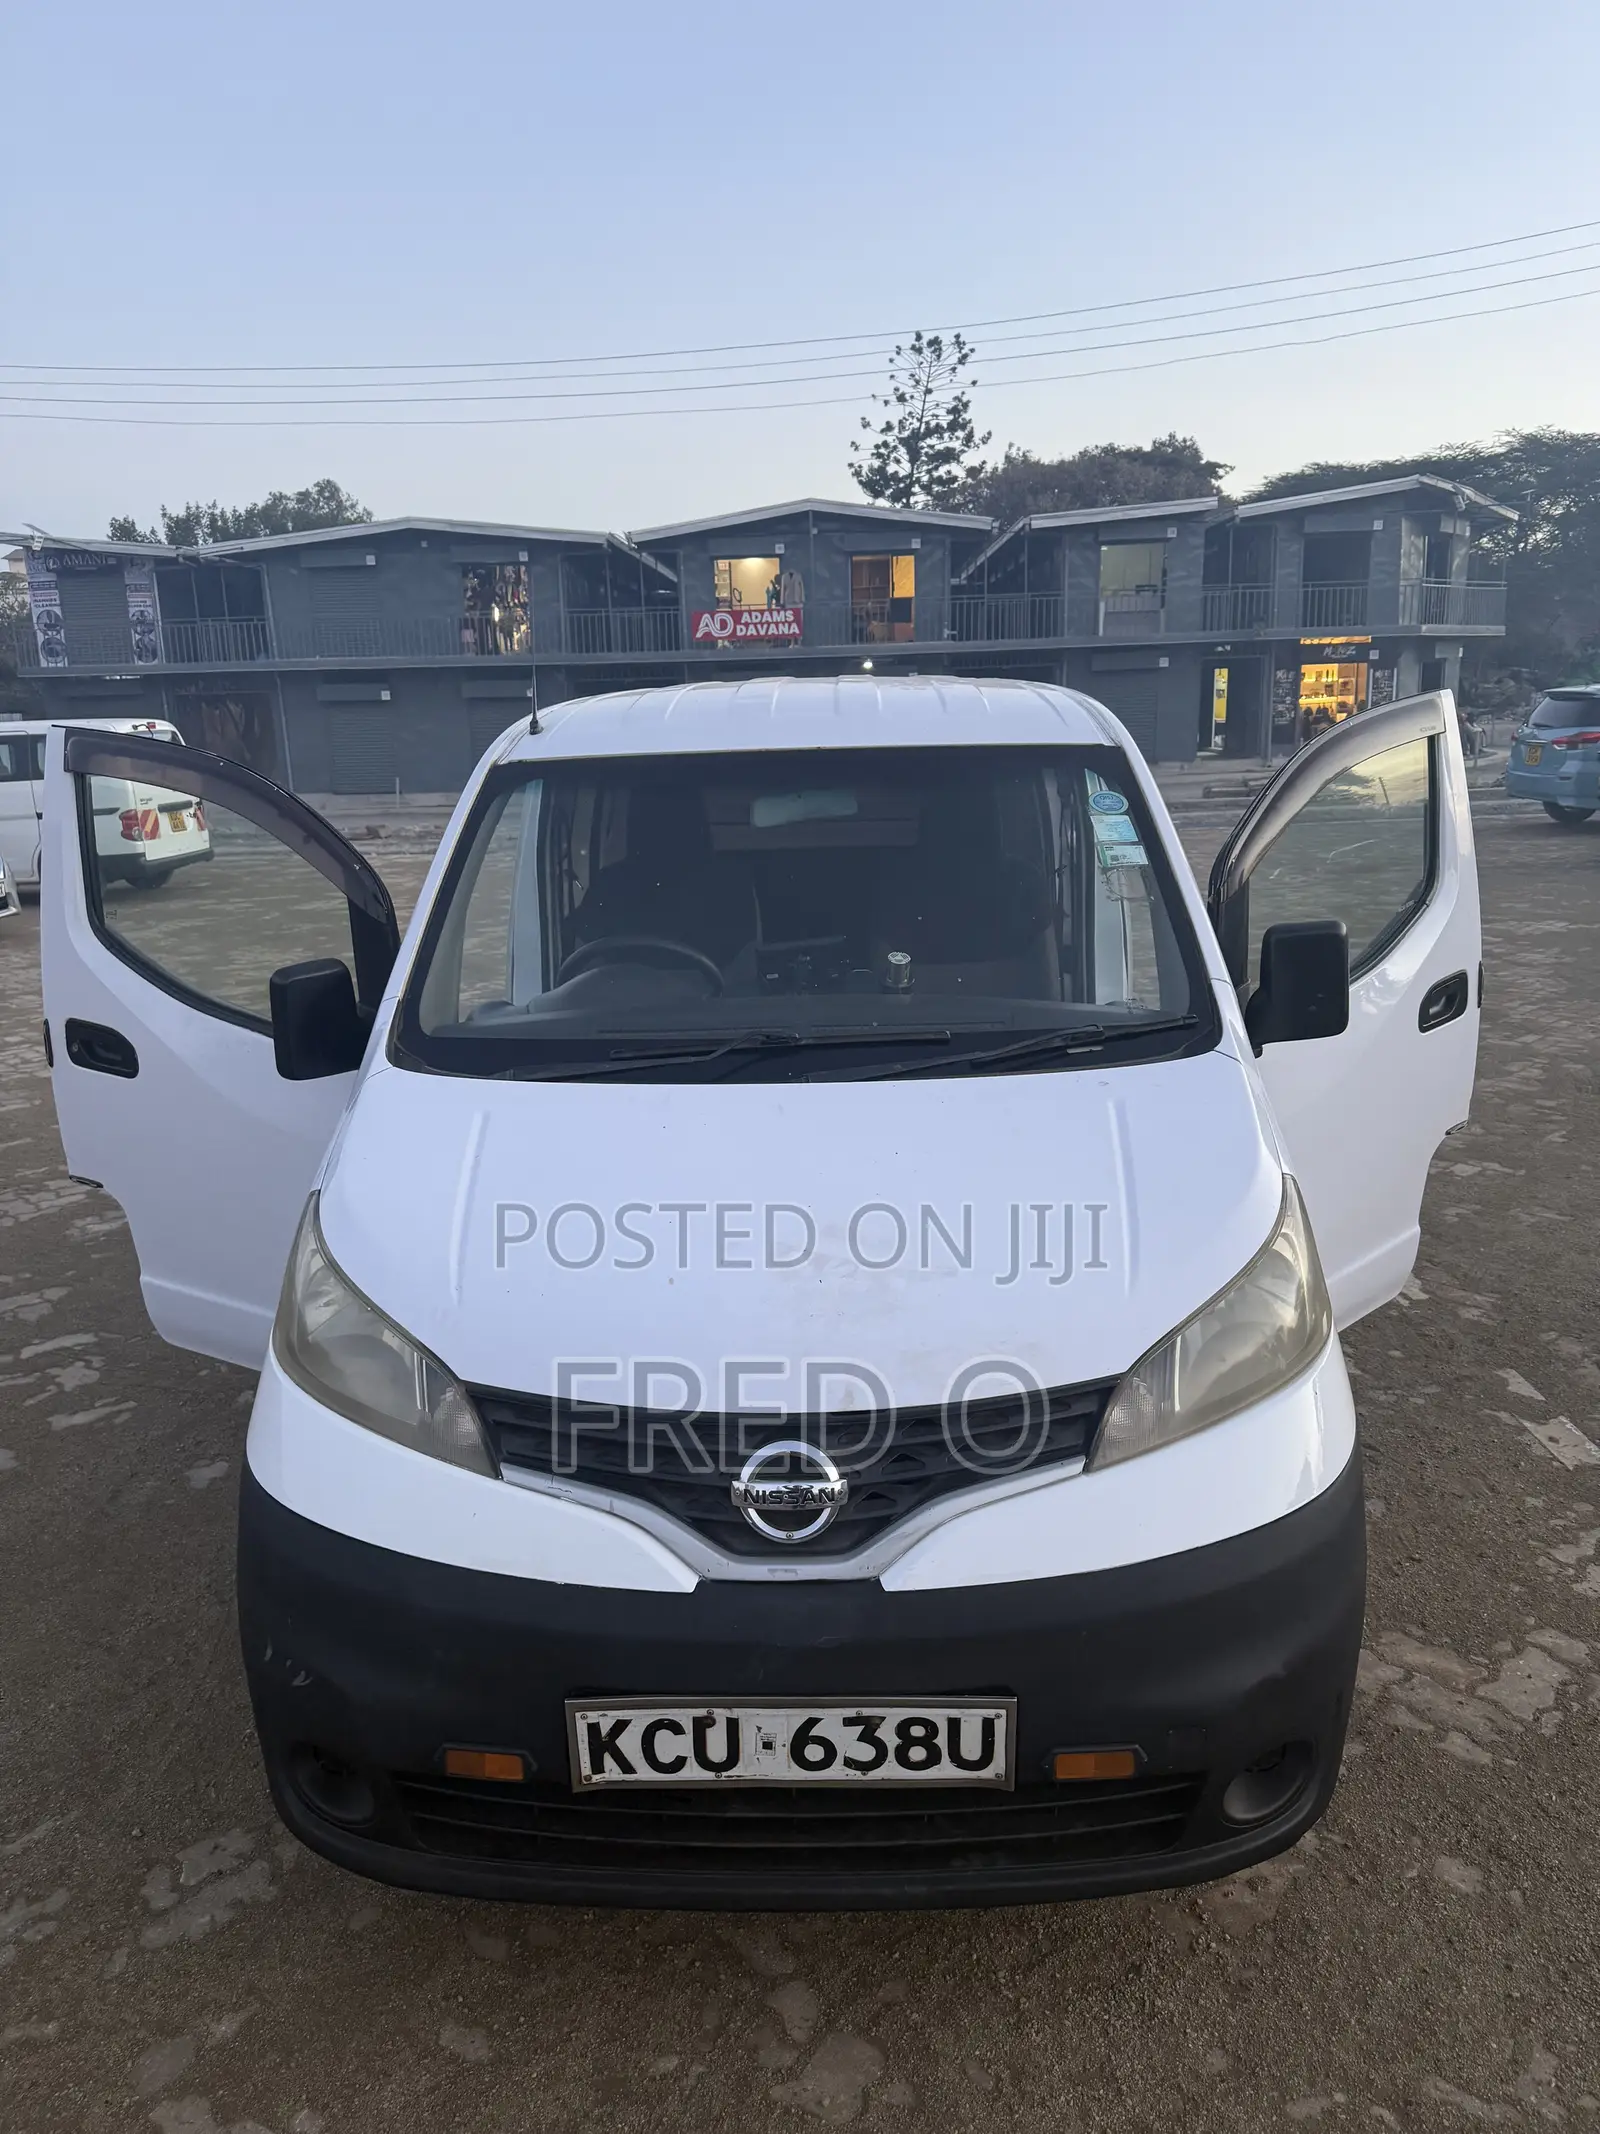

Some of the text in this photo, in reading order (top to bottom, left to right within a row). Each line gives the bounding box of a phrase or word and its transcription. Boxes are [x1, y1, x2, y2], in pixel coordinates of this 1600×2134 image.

[63, 554, 107, 566] AMANI
[741, 610, 795, 624] ADAMS
[736, 623, 800, 636] DAVANA
[743, 1487, 835, 1505] NISSAN
[587, 1716, 740, 1775] KCU
[790, 1715, 997, 1772] 638U
